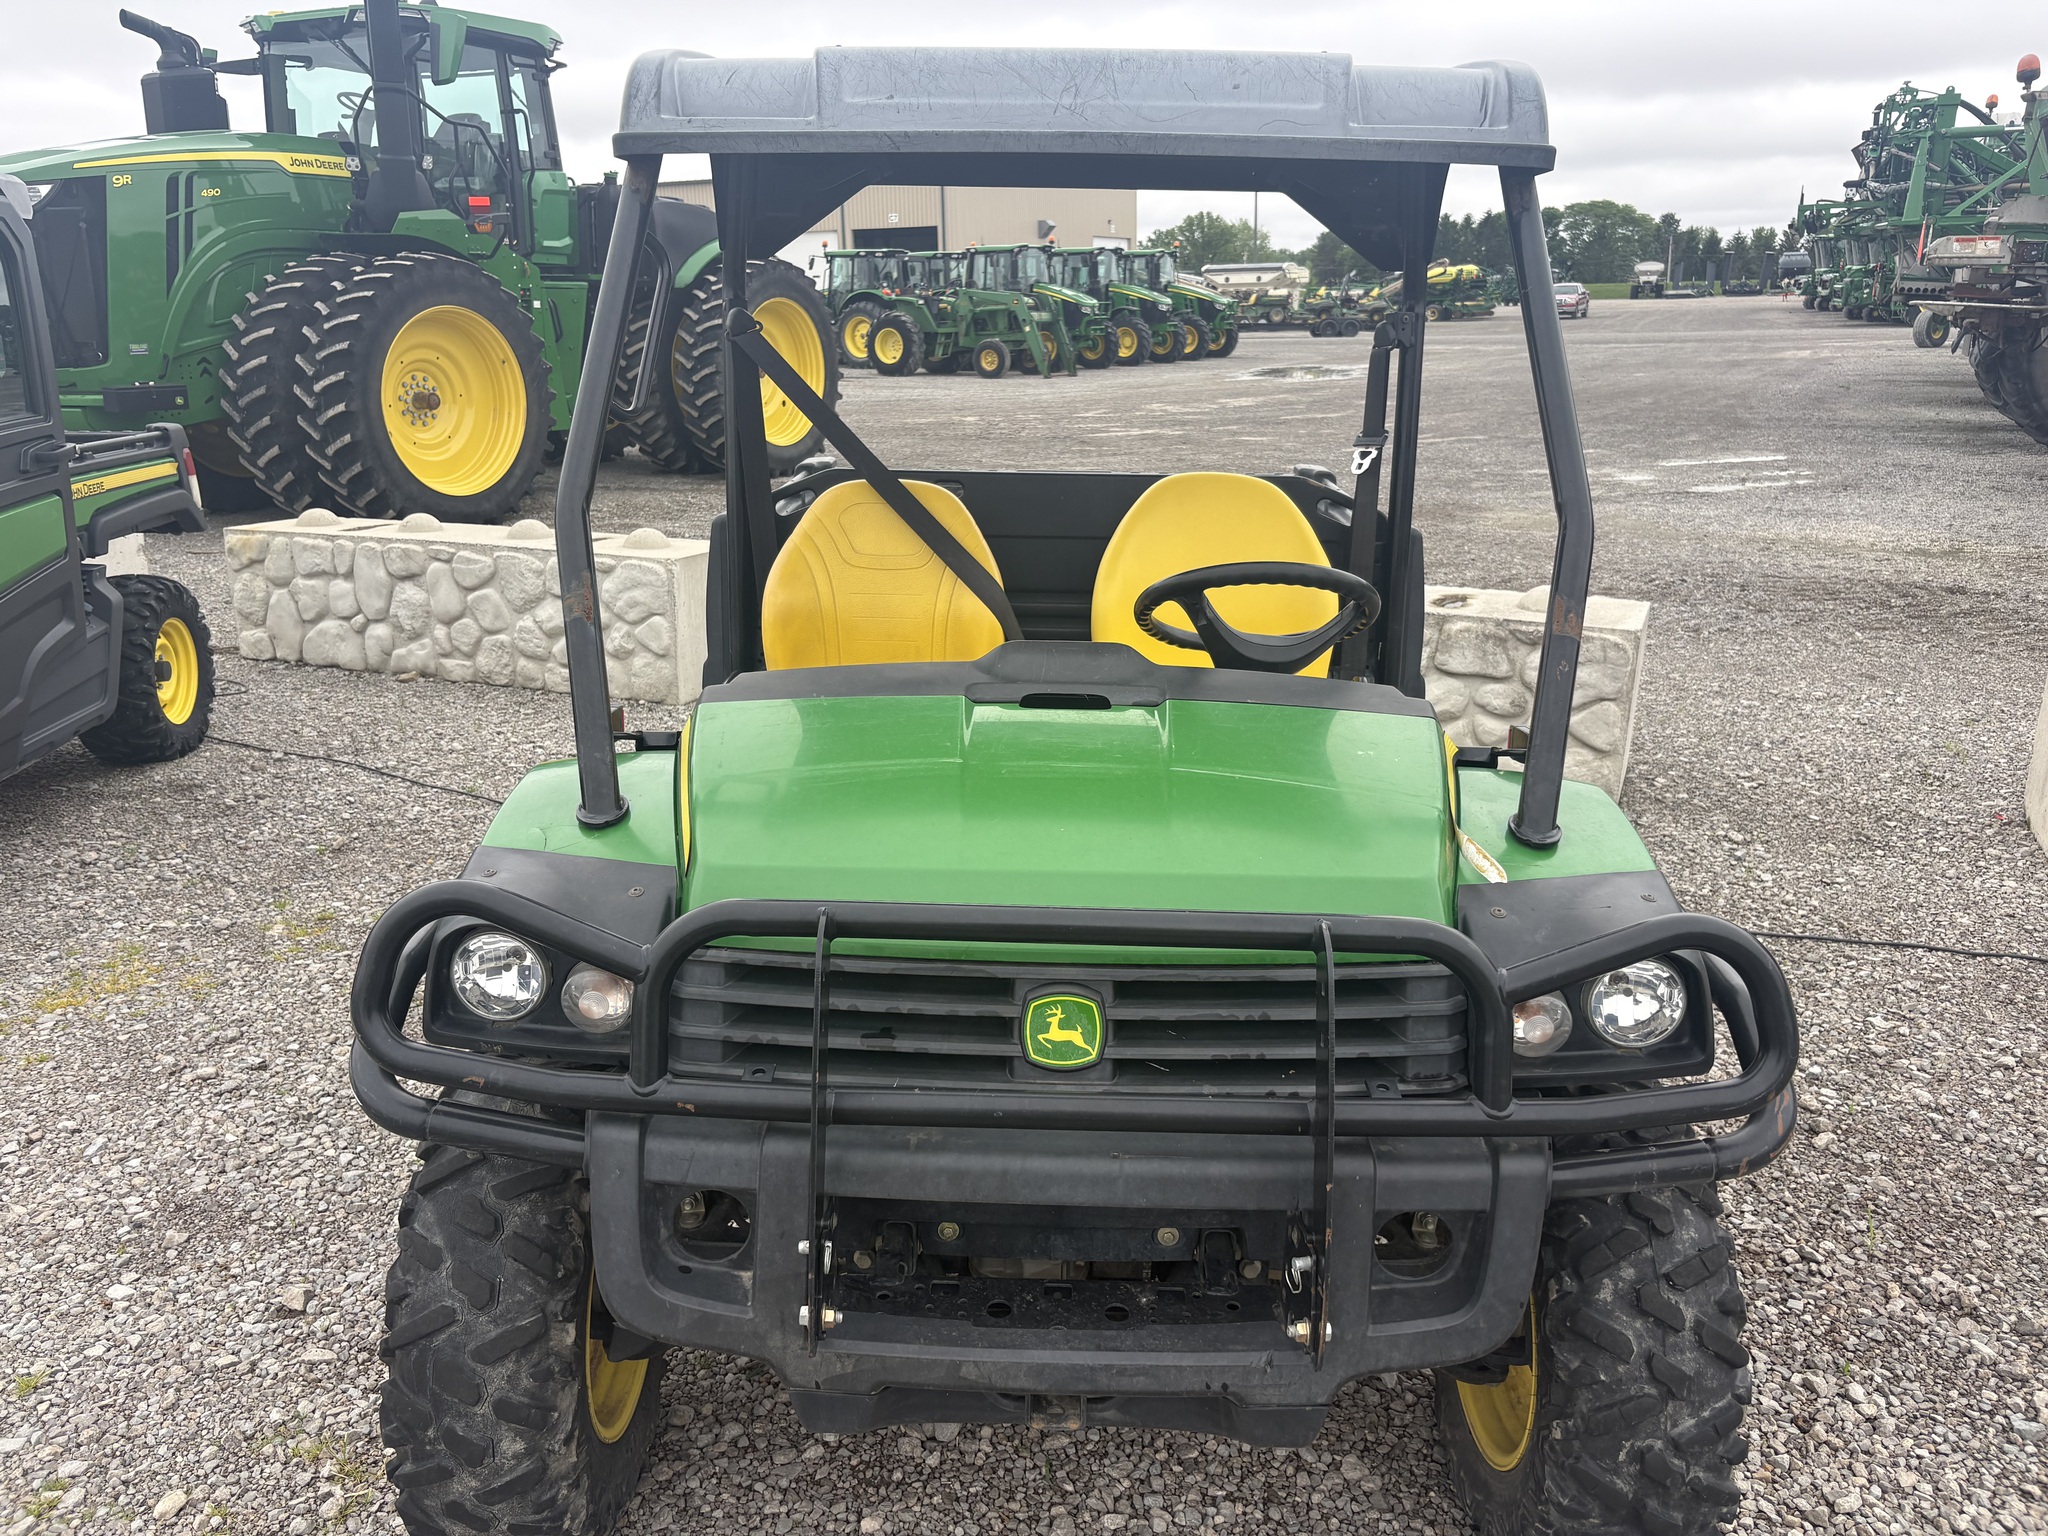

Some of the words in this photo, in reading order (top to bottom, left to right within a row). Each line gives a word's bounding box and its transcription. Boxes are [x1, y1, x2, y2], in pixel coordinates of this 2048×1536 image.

[290, 156, 315, 168] JOHN
[315, 158, 345, 171] DEERE
[112, 174, 132, 187] 9R
[200, 188, 221, 197] 490
[82, 481, 105, 495] DEERE
